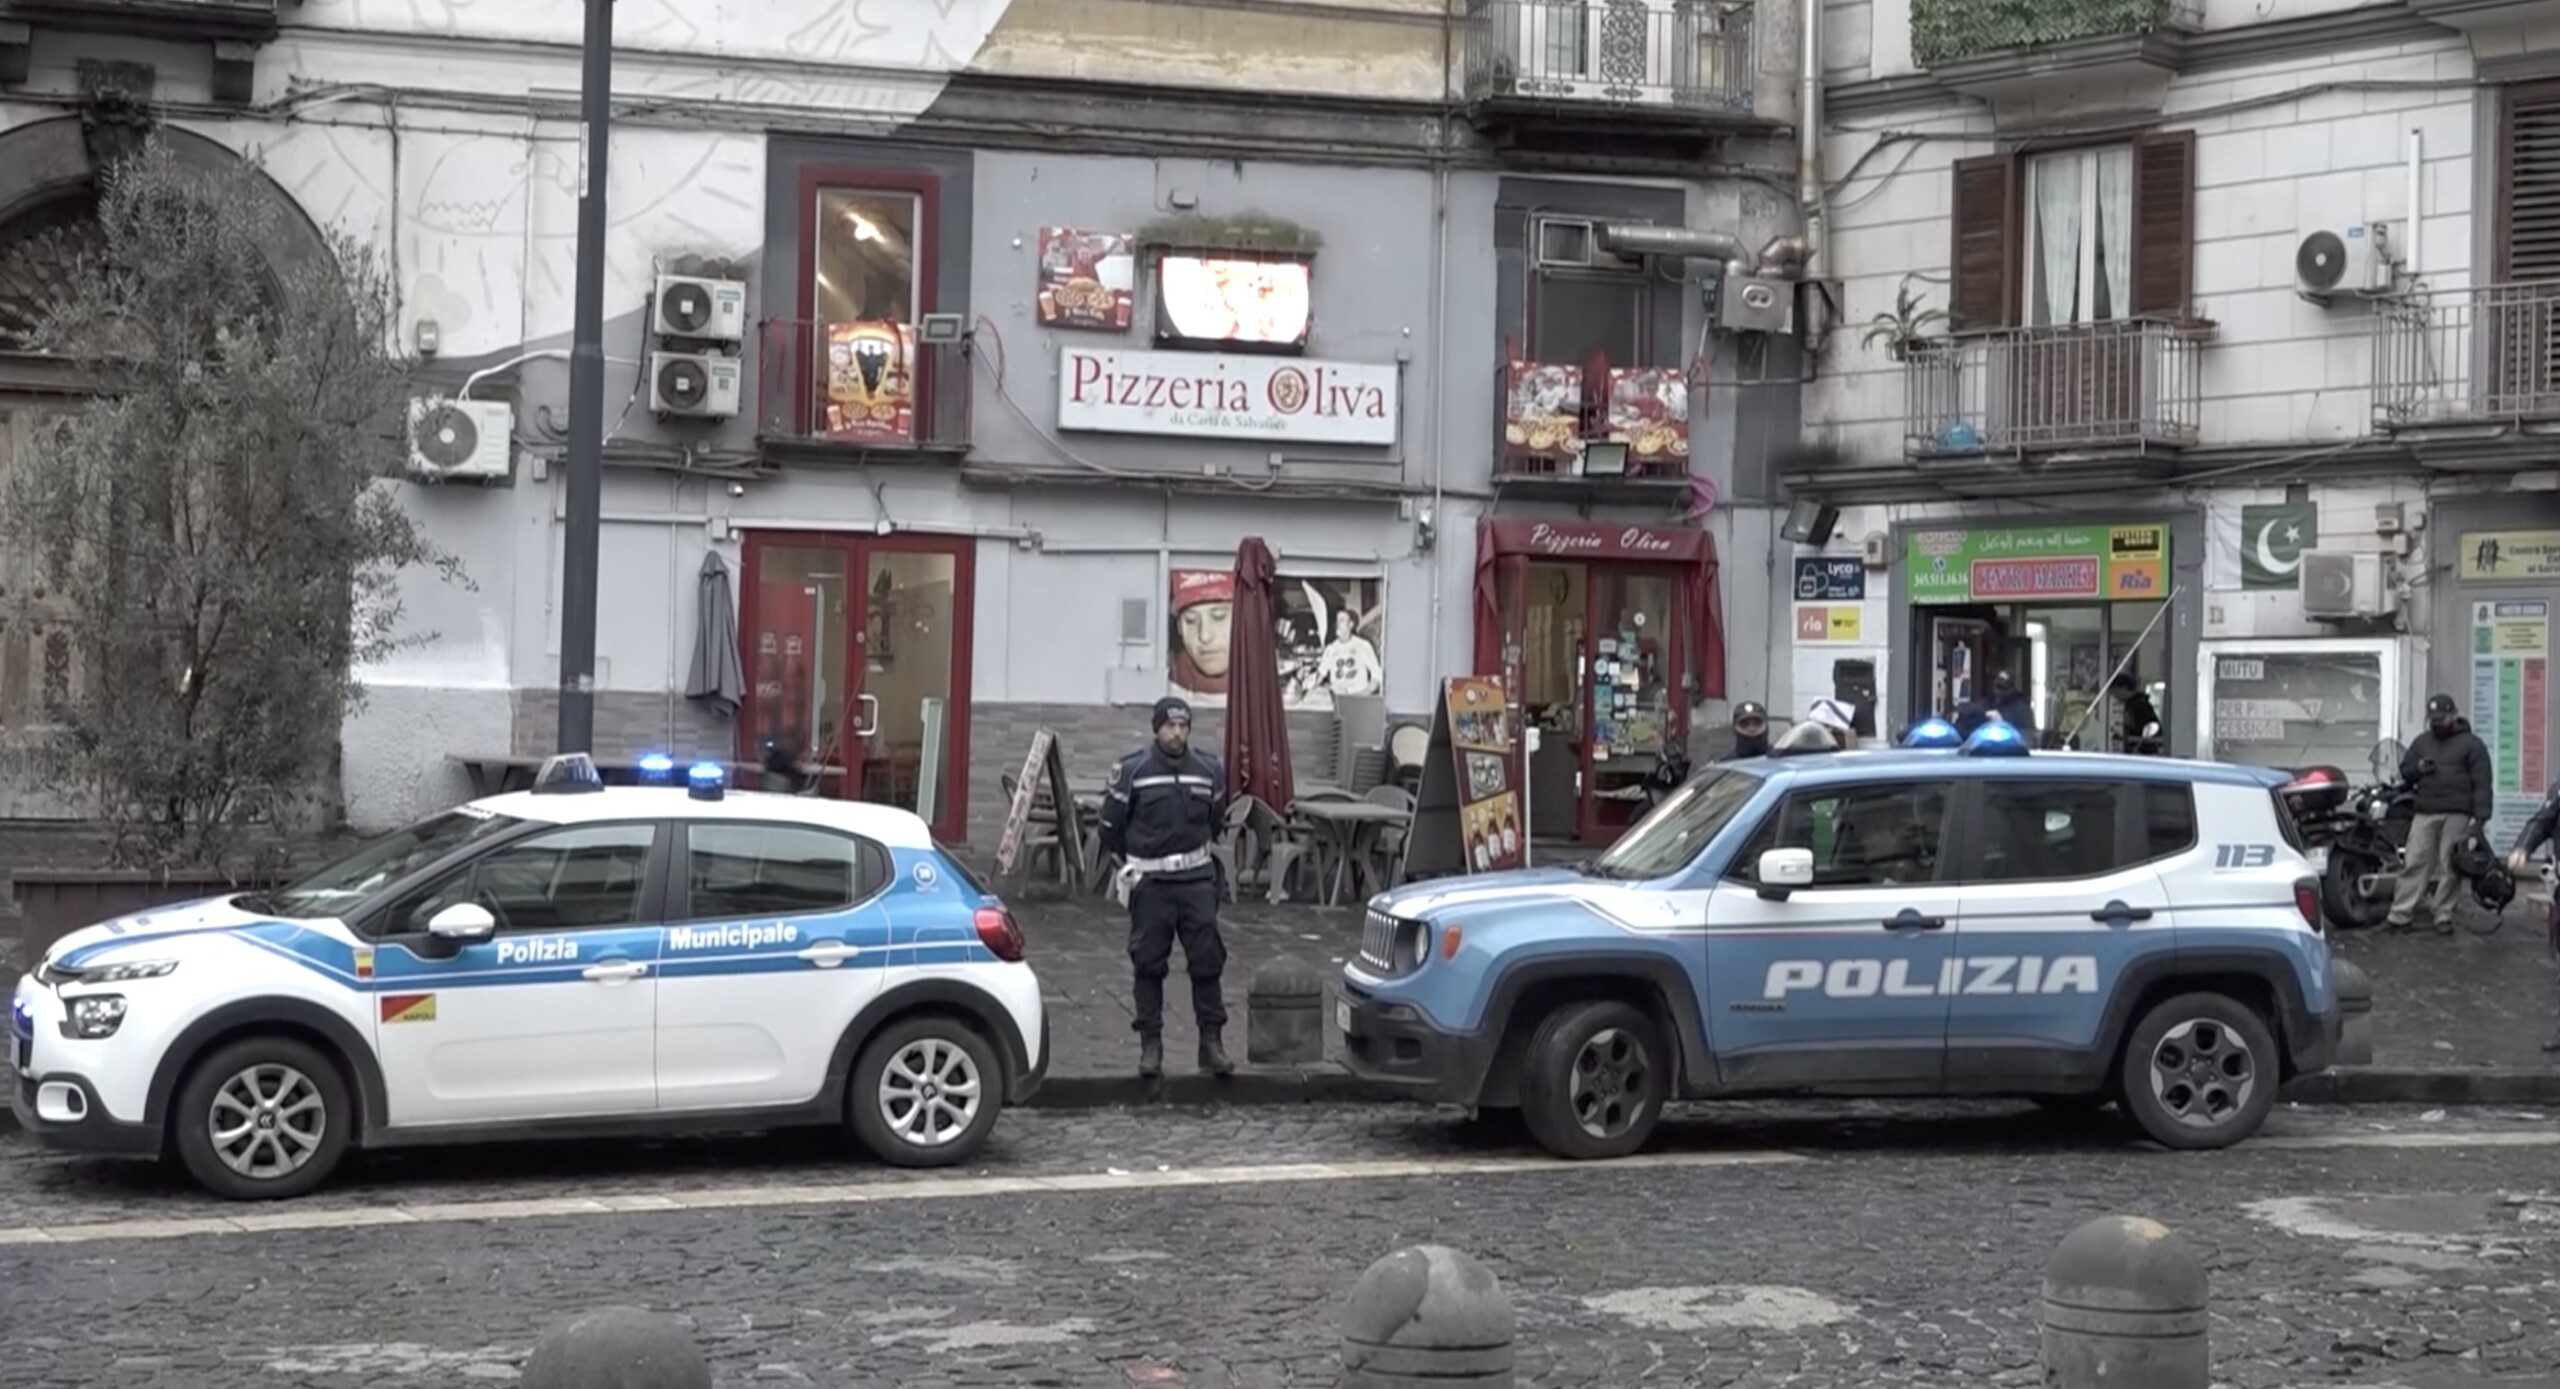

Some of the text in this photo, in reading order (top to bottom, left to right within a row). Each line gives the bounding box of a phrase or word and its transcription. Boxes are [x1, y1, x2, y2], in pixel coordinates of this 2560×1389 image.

[1069, 354, 1386, 418] Pizzeria Oliva
[1170, 412, 1184, 425] da
[1221, 416, 1231, 427] &
[1531, 524, 1671, 551] Pizzeria Oliva
[1828, 562, 1854, 576] Lyca
[2120, 567, 2152, 590] Ria
[1803, 614, 1823, 632] ria
[2220, 661, 2259, 678] MUTU
[2219, 702, 2244, 718] PER
[2215, 844, 2276, 867] 113
[497, 922, 798, 964] Polizia Municipale
[1763, 955, 2100, 998] POLIZIA
[403, 1012, 436, 1021] NAPOLI
